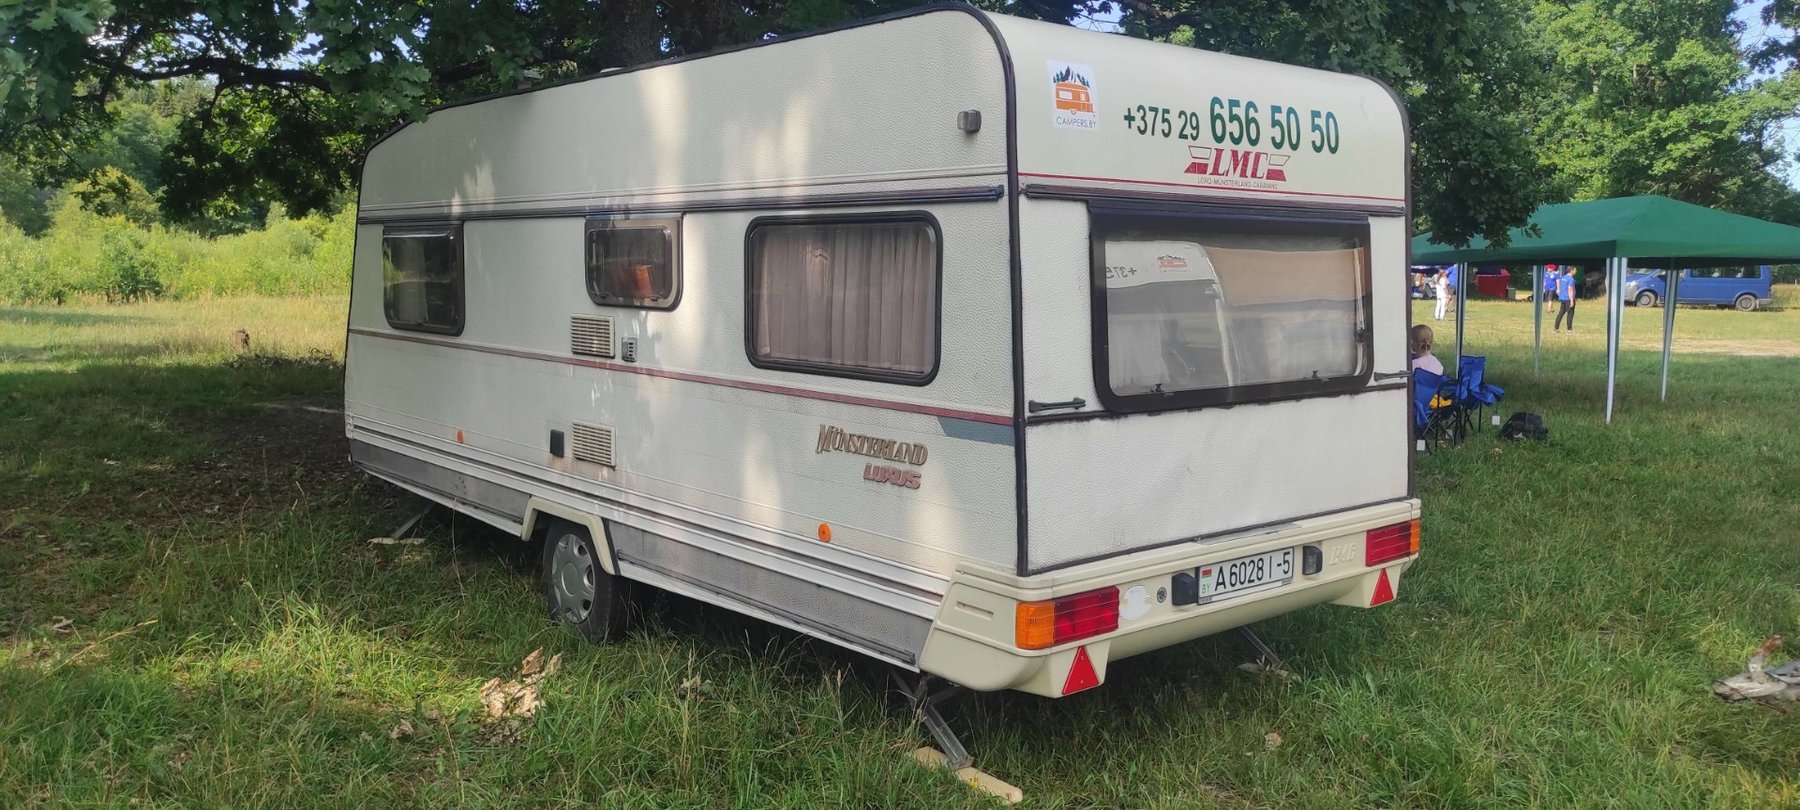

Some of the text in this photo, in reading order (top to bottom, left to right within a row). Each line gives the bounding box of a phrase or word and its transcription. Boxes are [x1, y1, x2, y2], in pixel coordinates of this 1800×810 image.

[1124, 96, 1340, 154] +375 29 656 50 50
[1209, 148, 1268, 179] LMC
[863, 463, 921, 489] LUXUS
[1202, 583, 1211, 594] BY
